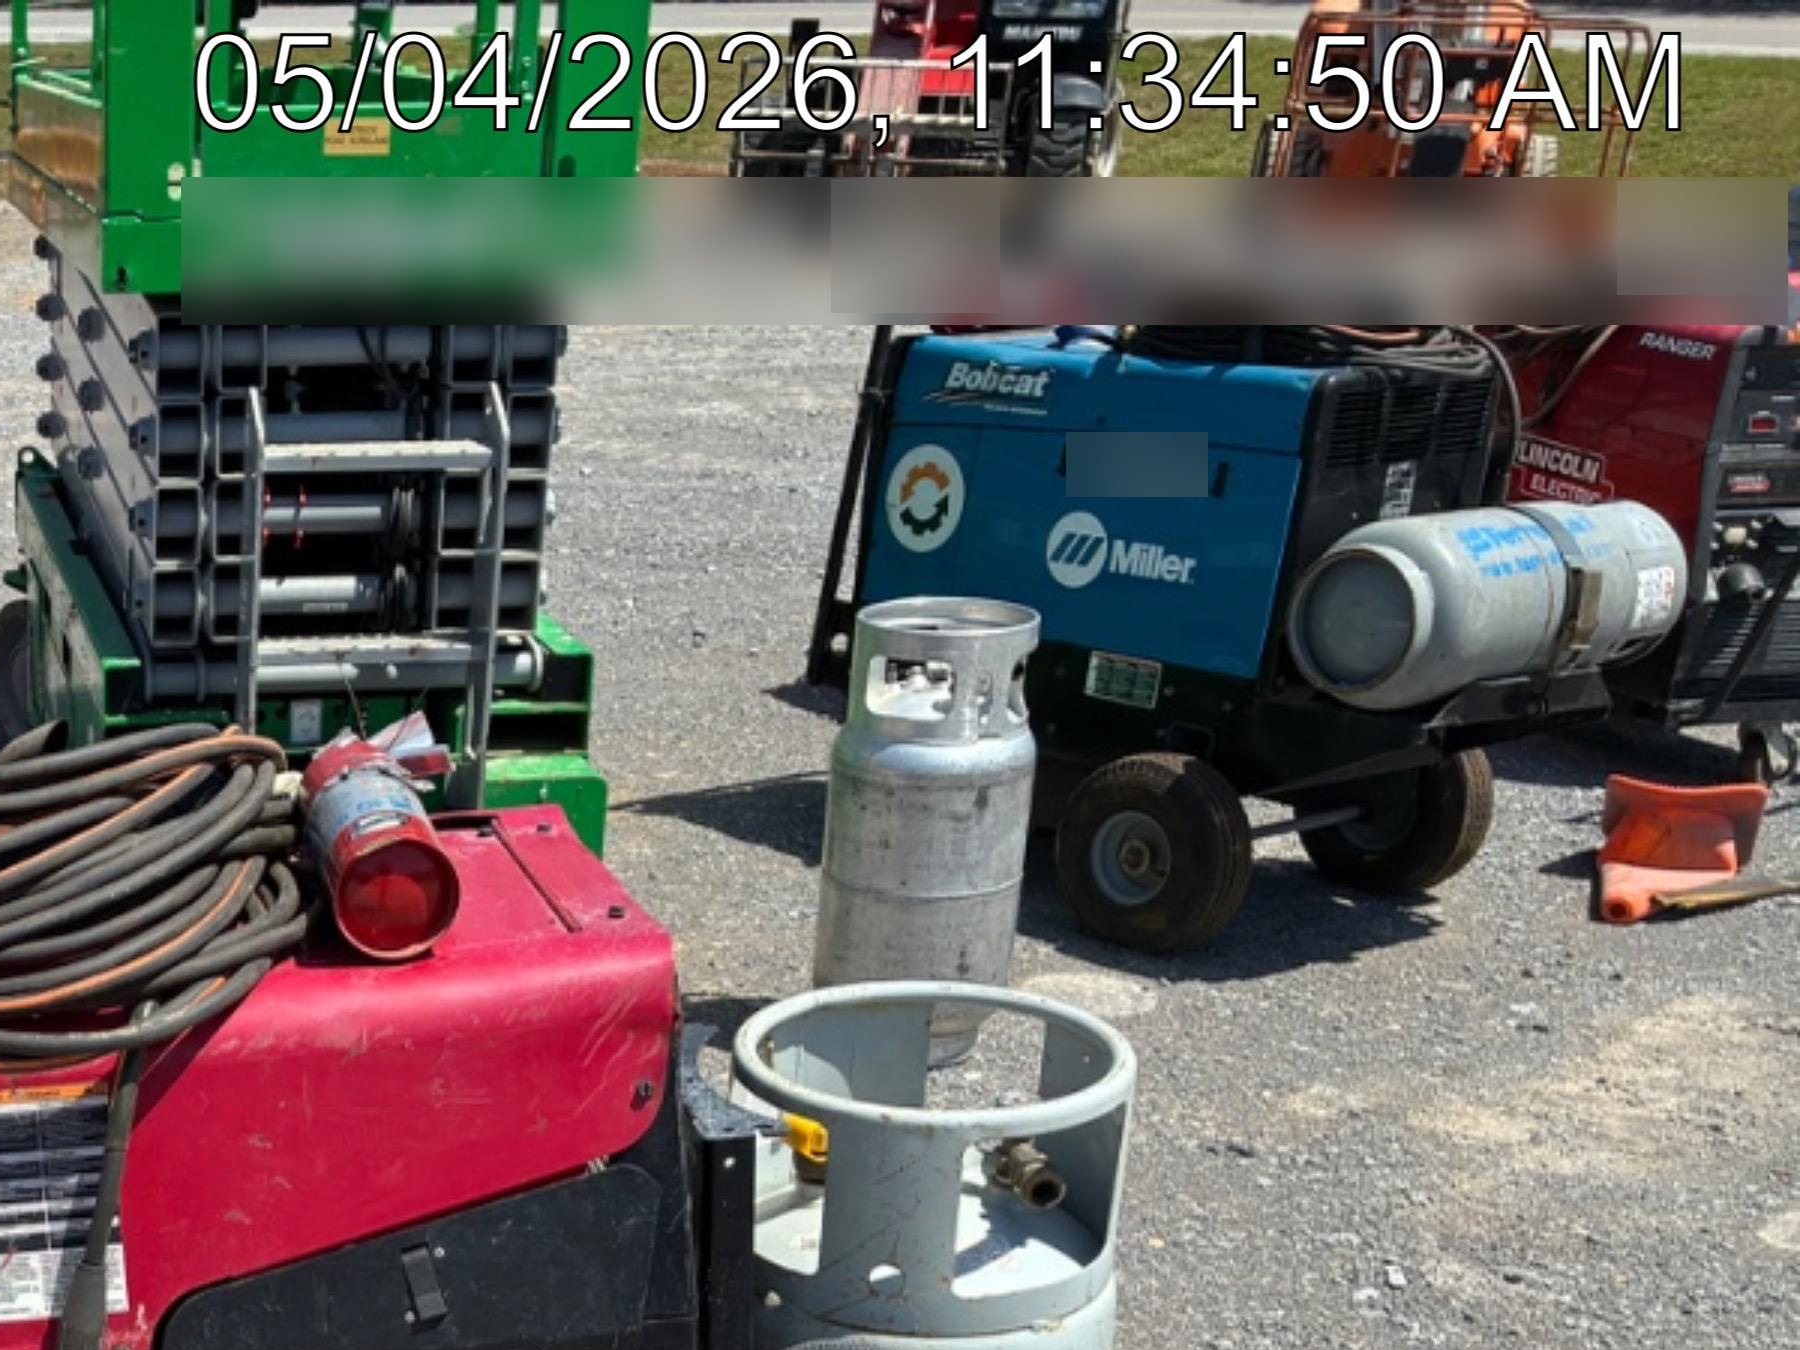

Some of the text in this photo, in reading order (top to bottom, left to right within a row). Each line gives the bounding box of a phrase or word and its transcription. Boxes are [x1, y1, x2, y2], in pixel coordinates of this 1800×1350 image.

[1639, 332, 1718, 360] RANGER
[944, 361, 1050, 397] Bobcat
[1518, 440, 1601, 483] LINCOLN
[1109, 540, 1197, 583] Miller
